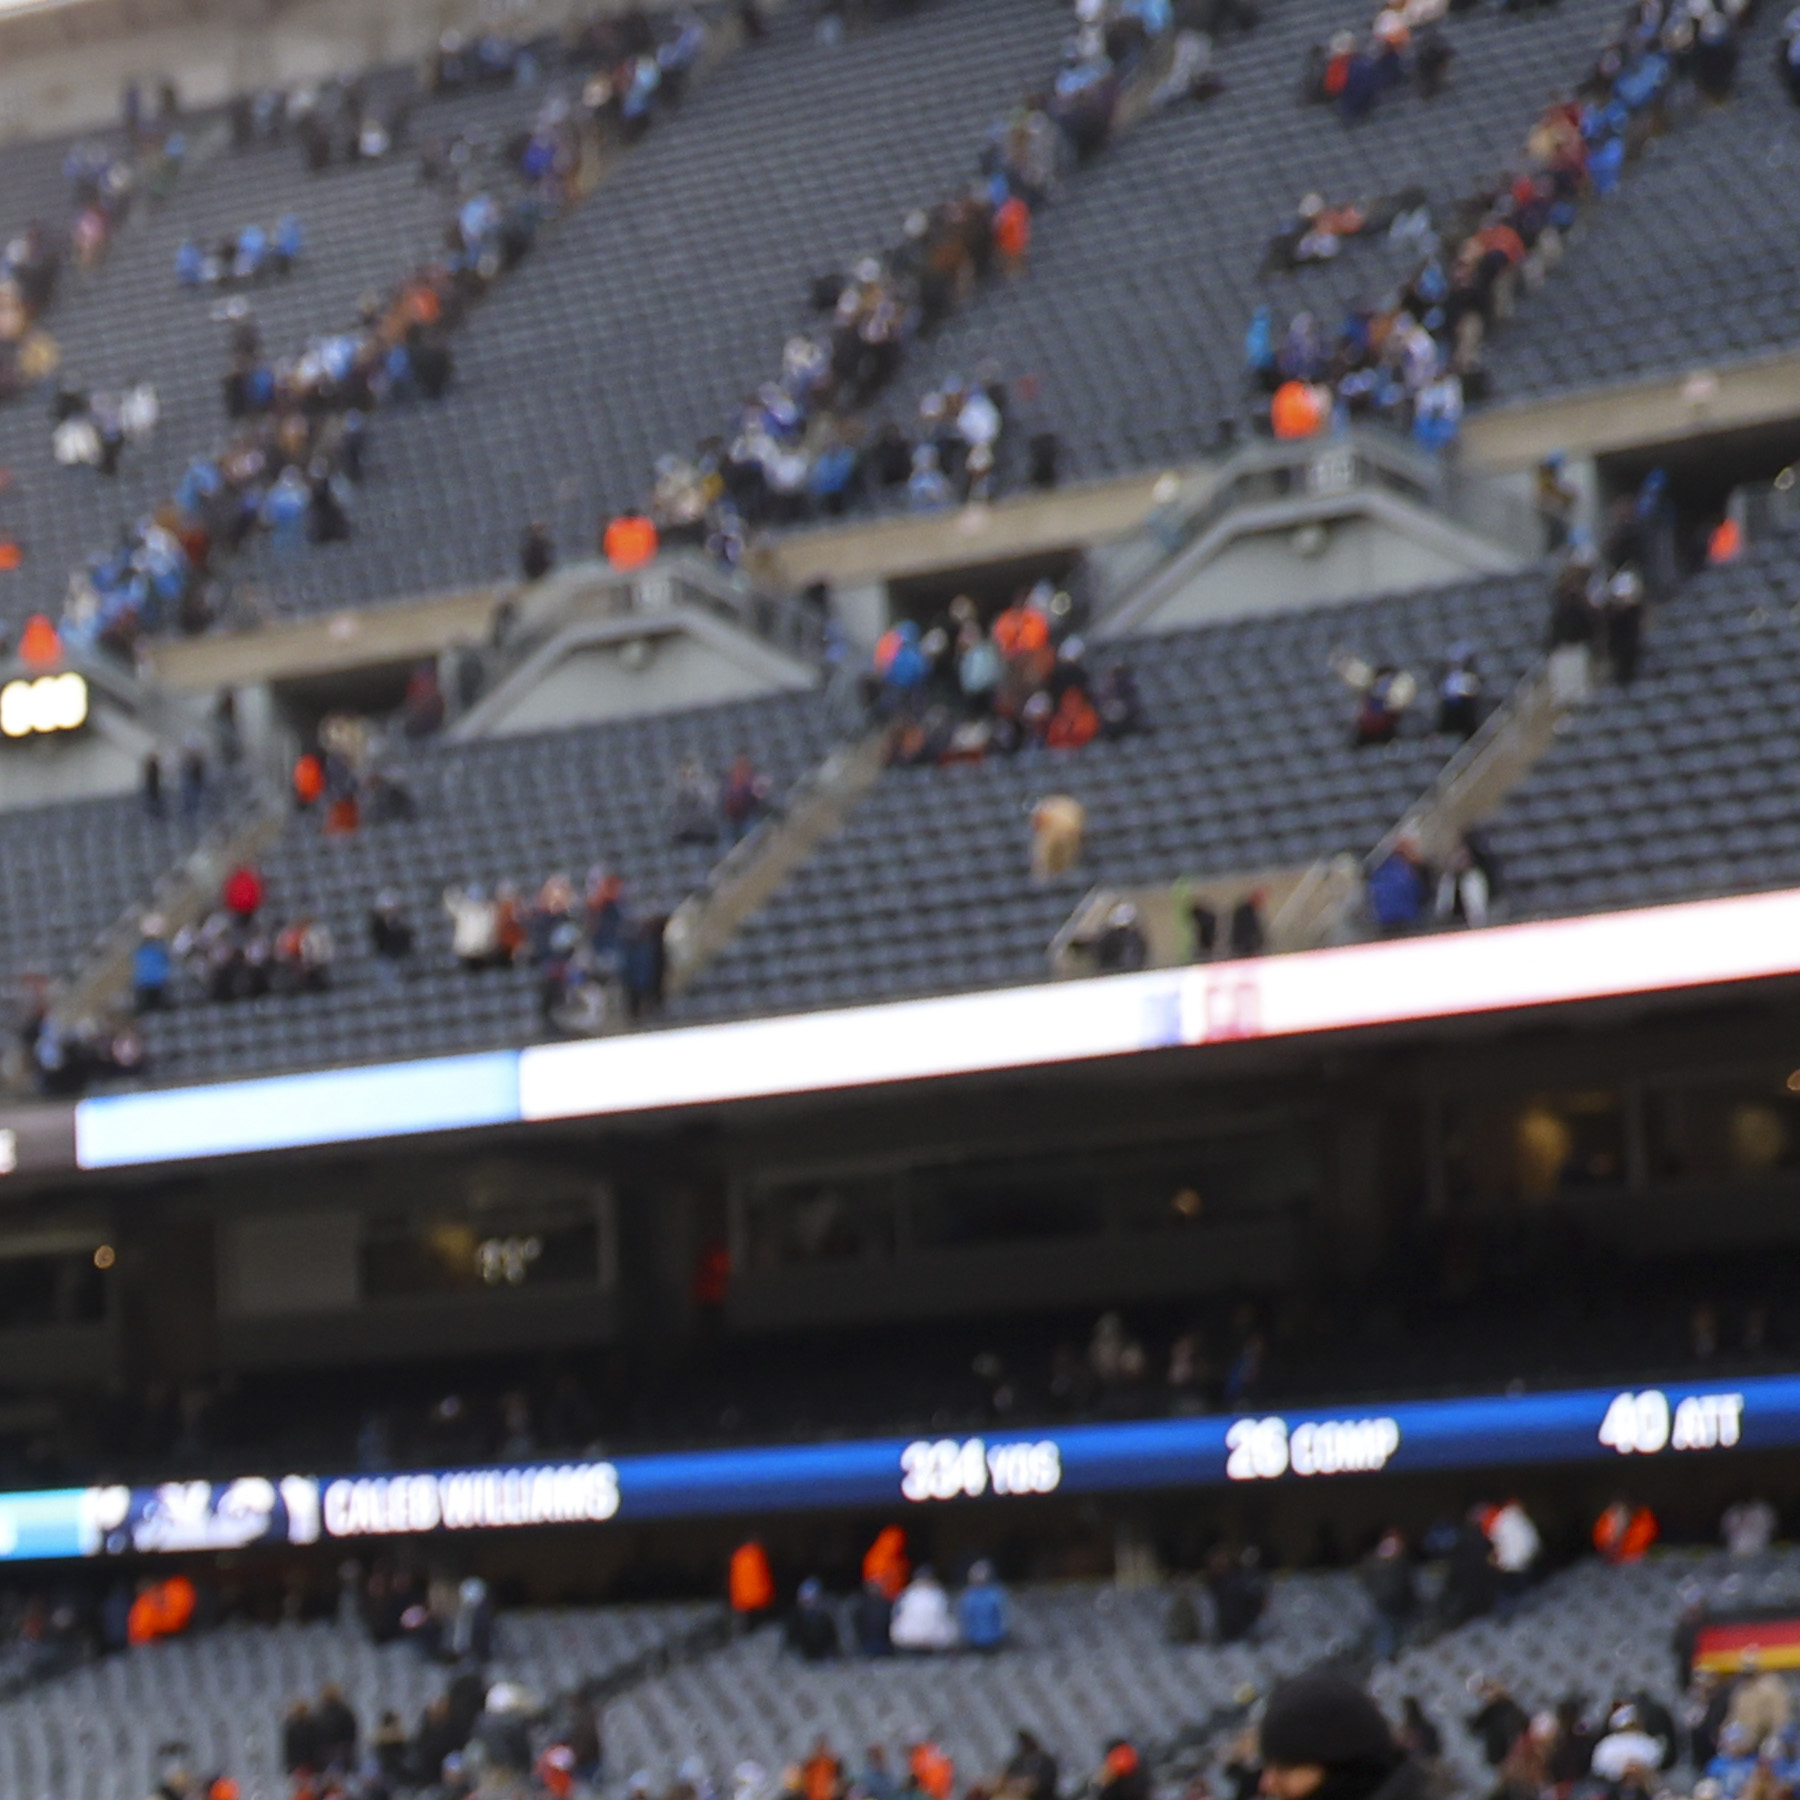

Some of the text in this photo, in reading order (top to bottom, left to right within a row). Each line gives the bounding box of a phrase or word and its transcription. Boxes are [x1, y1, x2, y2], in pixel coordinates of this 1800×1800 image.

[1290, 1416, 1399, 1476] COMP
[1598, 1389, 1744, 1454] 40 ATT
[323, 1461, 620, 1536] CALEB WILLIAMS
[986, 1440, 1062, 1495] YDS
